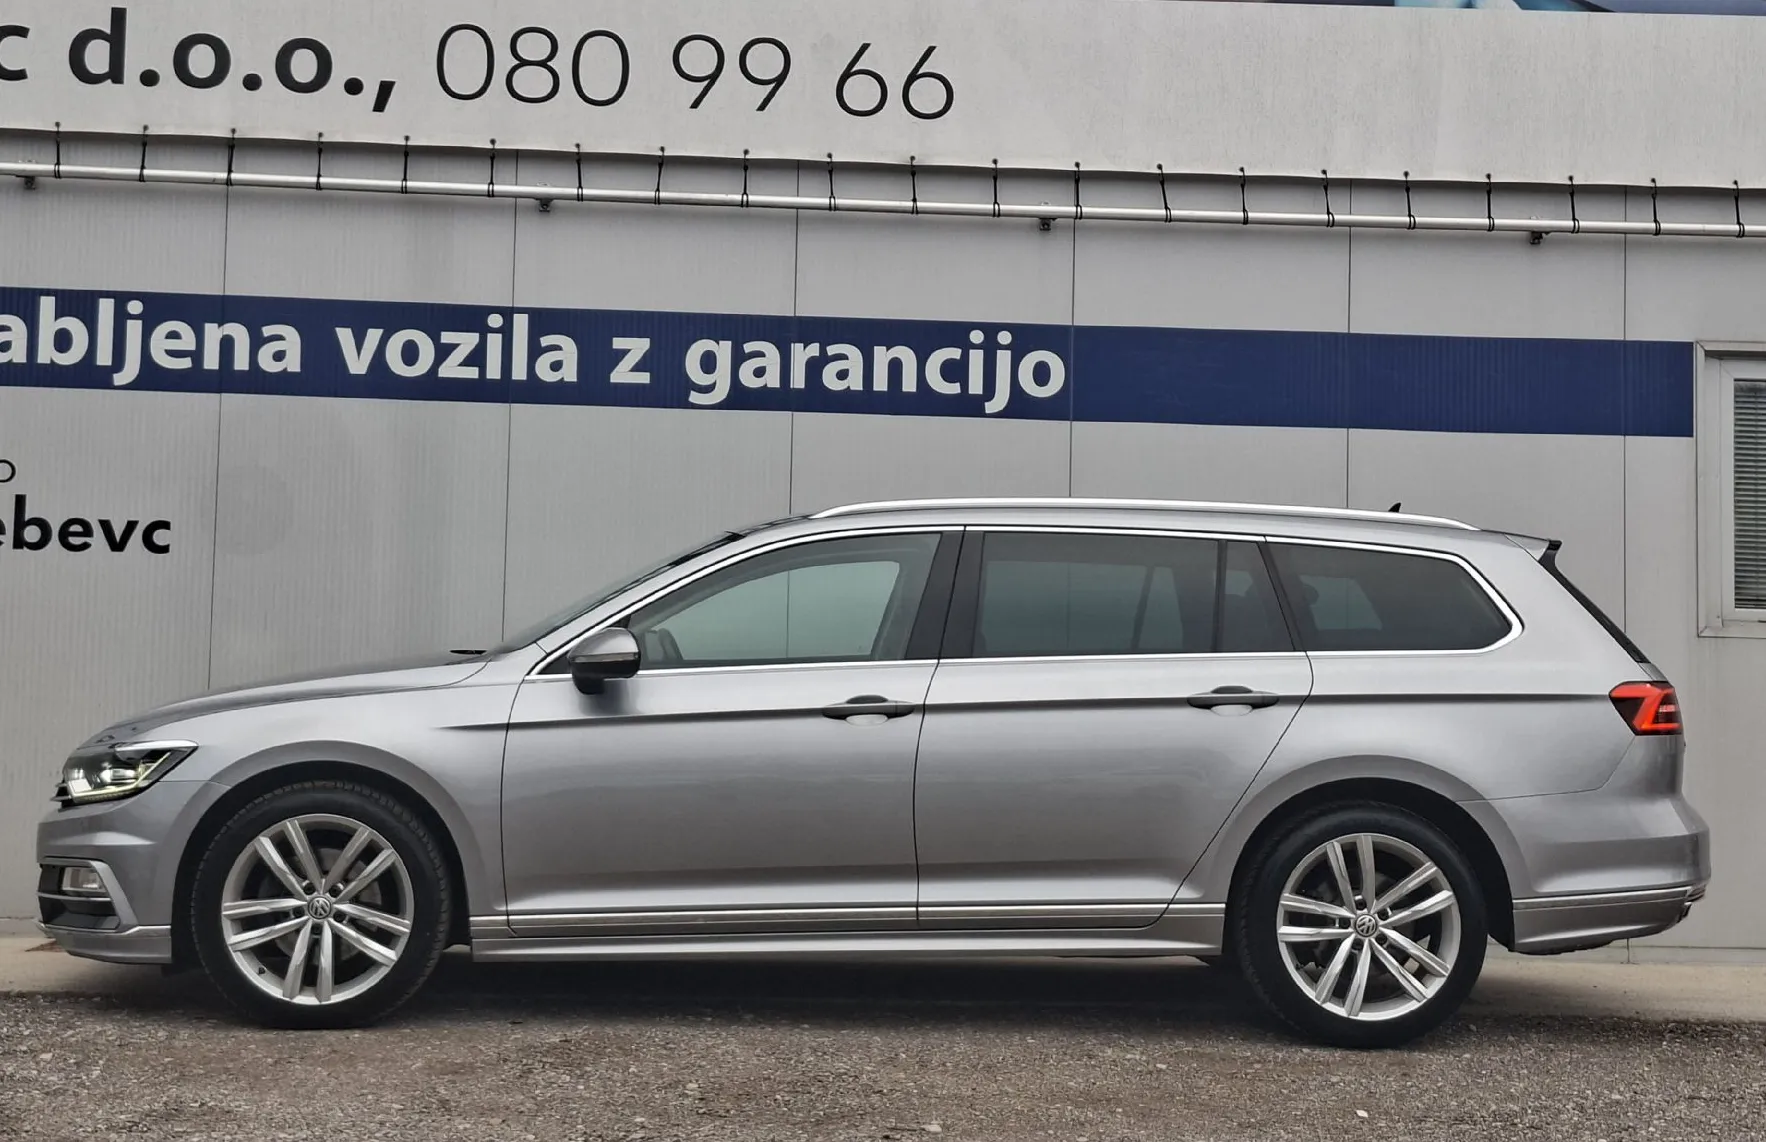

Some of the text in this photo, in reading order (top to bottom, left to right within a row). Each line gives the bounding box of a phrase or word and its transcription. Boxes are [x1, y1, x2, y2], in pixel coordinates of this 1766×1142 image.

[68, 7, 396, 113] d.o.o.,
[436, 23, 630, 107] 080
[672, 34, 792, 112] 99
[835, 42, 955, 120] 66
[0, 296, 1066, 414] abljena vozila z garancijo
[0, 494, 172, 555] bevc
